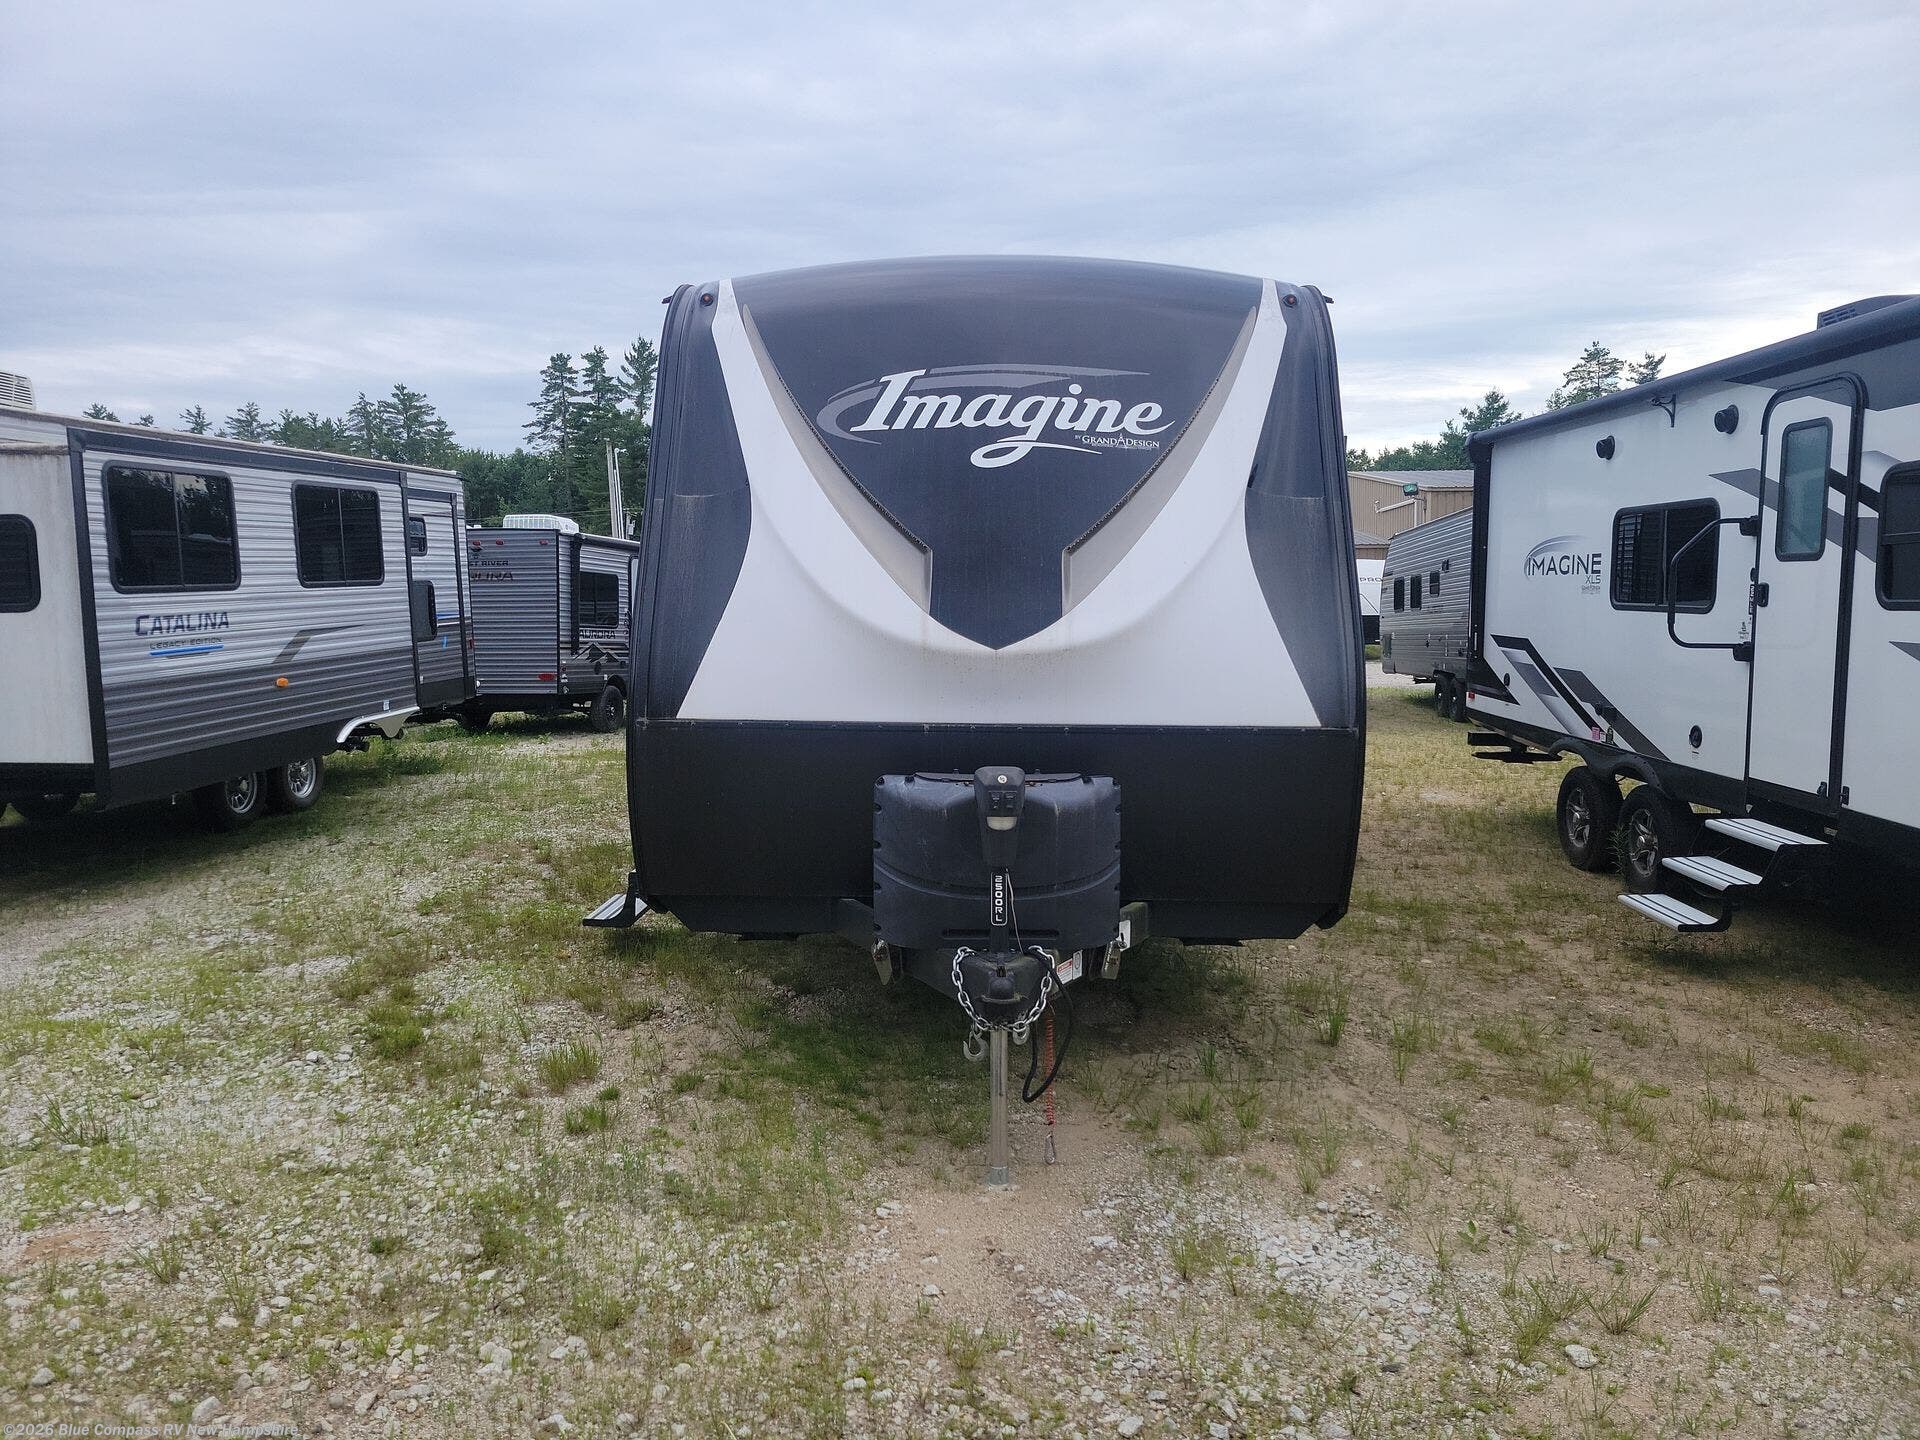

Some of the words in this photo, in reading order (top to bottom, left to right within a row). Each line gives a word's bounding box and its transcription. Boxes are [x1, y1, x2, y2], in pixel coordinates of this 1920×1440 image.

[850, 369, 1175, 468] Imagine
[1527, 553, 1602, 576] IMAGINE
[135, 611, 229, 636] CATALINA
[995, 875, 1003, 922] 2500RL
